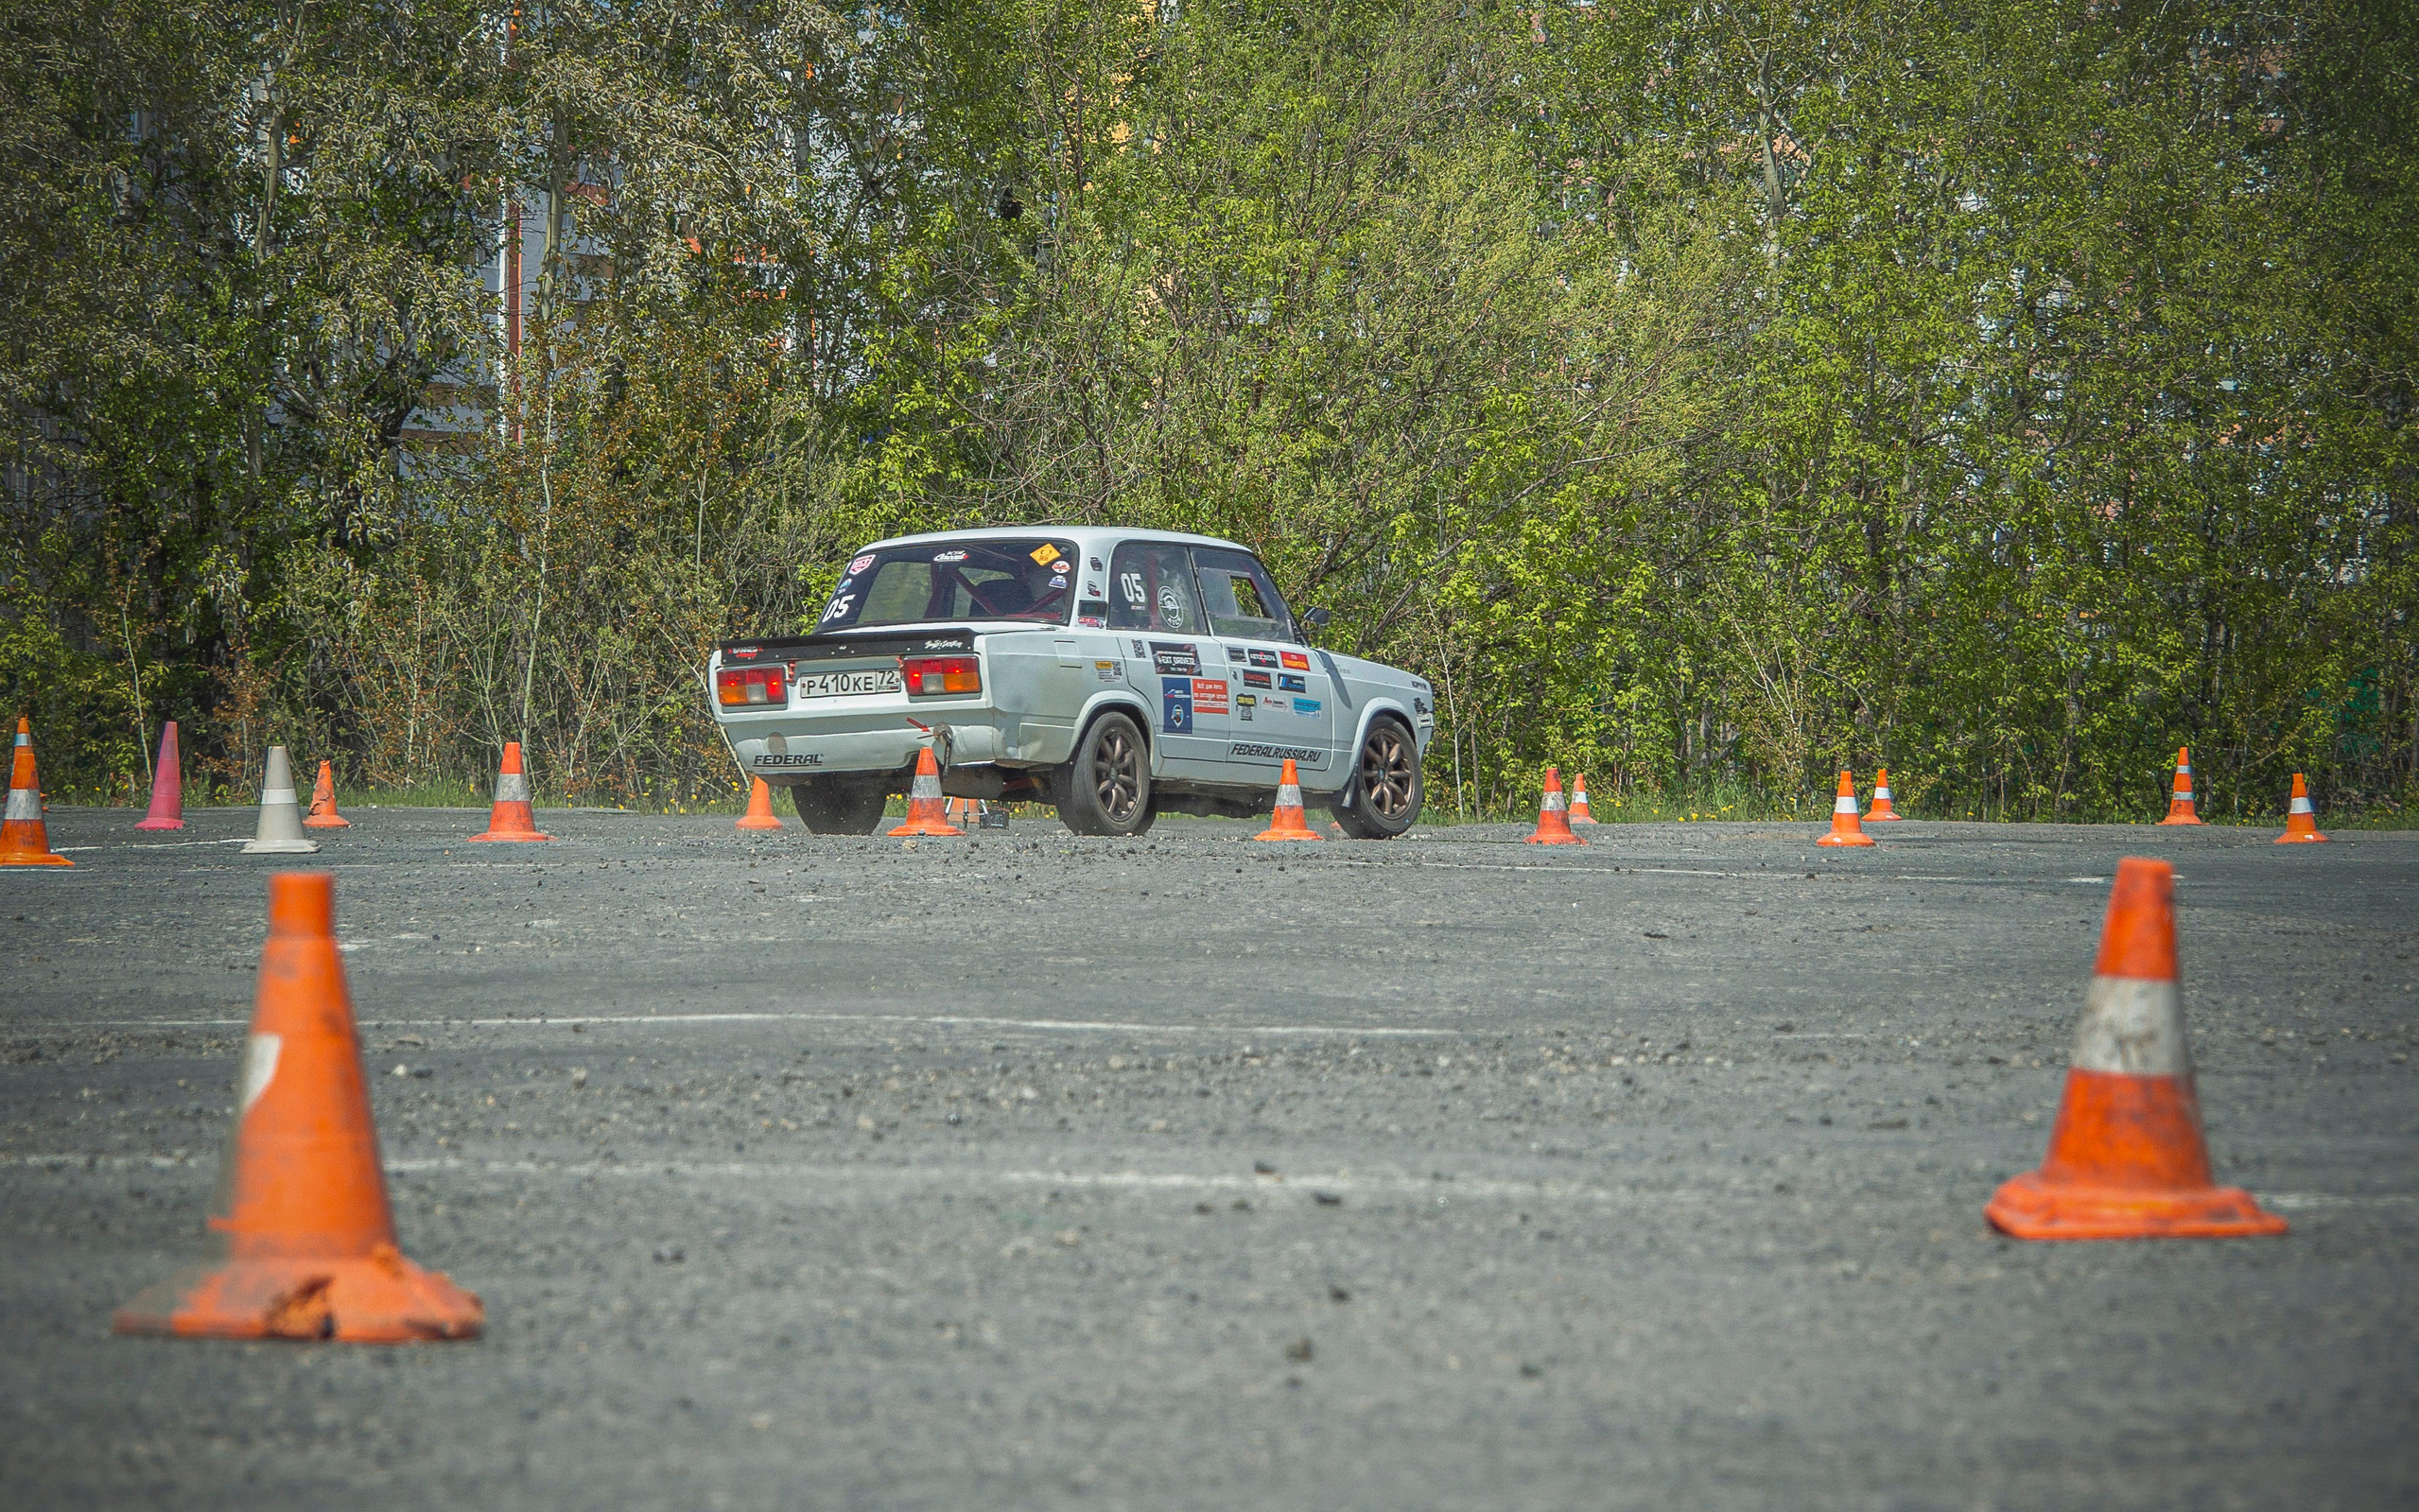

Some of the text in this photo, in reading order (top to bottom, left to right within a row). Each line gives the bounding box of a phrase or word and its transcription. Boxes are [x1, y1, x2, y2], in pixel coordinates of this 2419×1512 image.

[1121, 573, 1146, 602] 05
[822, 594, 856, 622] 05
[879, 669, 895, 685] 72
[754, 754, 824, 765] FEDERAL
[1231, 743, 1322, 762] FEDERALRUSSIA.RU
